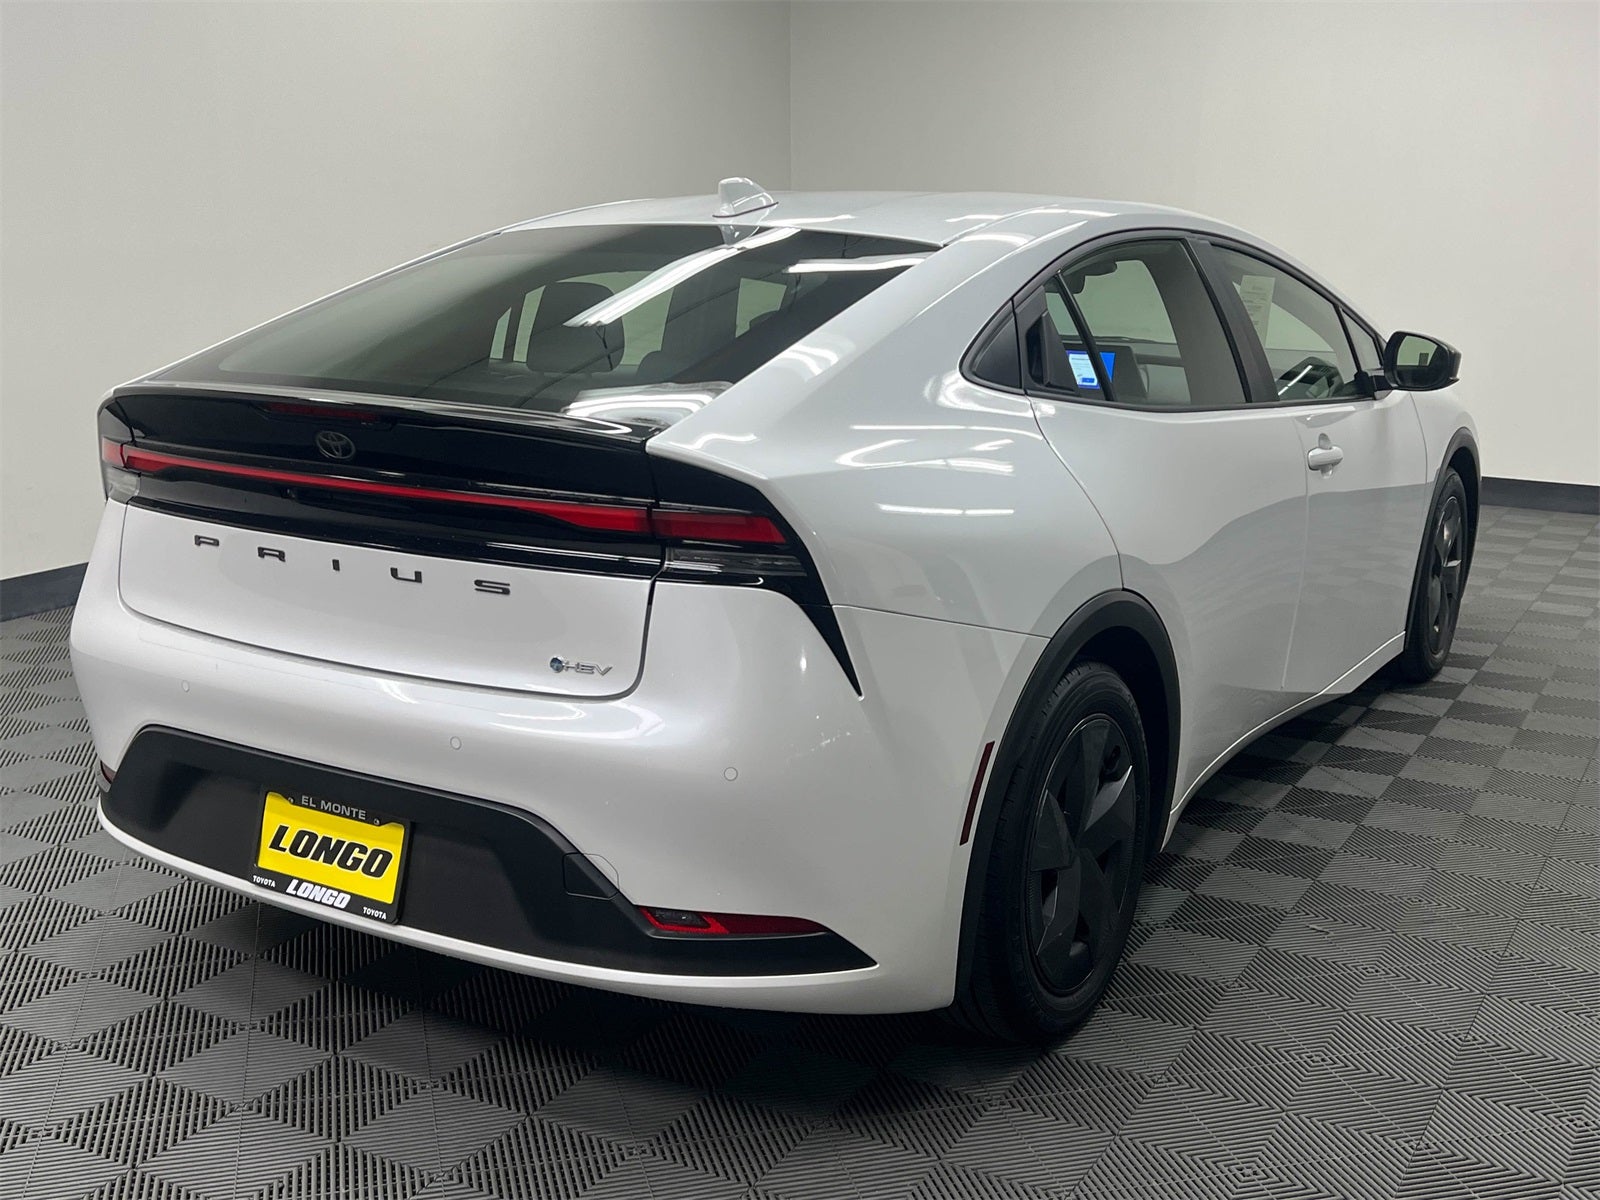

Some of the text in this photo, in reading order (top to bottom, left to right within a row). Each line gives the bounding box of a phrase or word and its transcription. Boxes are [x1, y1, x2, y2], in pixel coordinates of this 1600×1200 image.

[194, 534, 511, 595] PRIUS
[563, 660, 613, 676] HEV
[301, 795, 366, 820] EL MONTE
[268, 824, 393, 878] LONGO
[252, 875, 387, 920] TOYOTA LONGO TOYOTA
